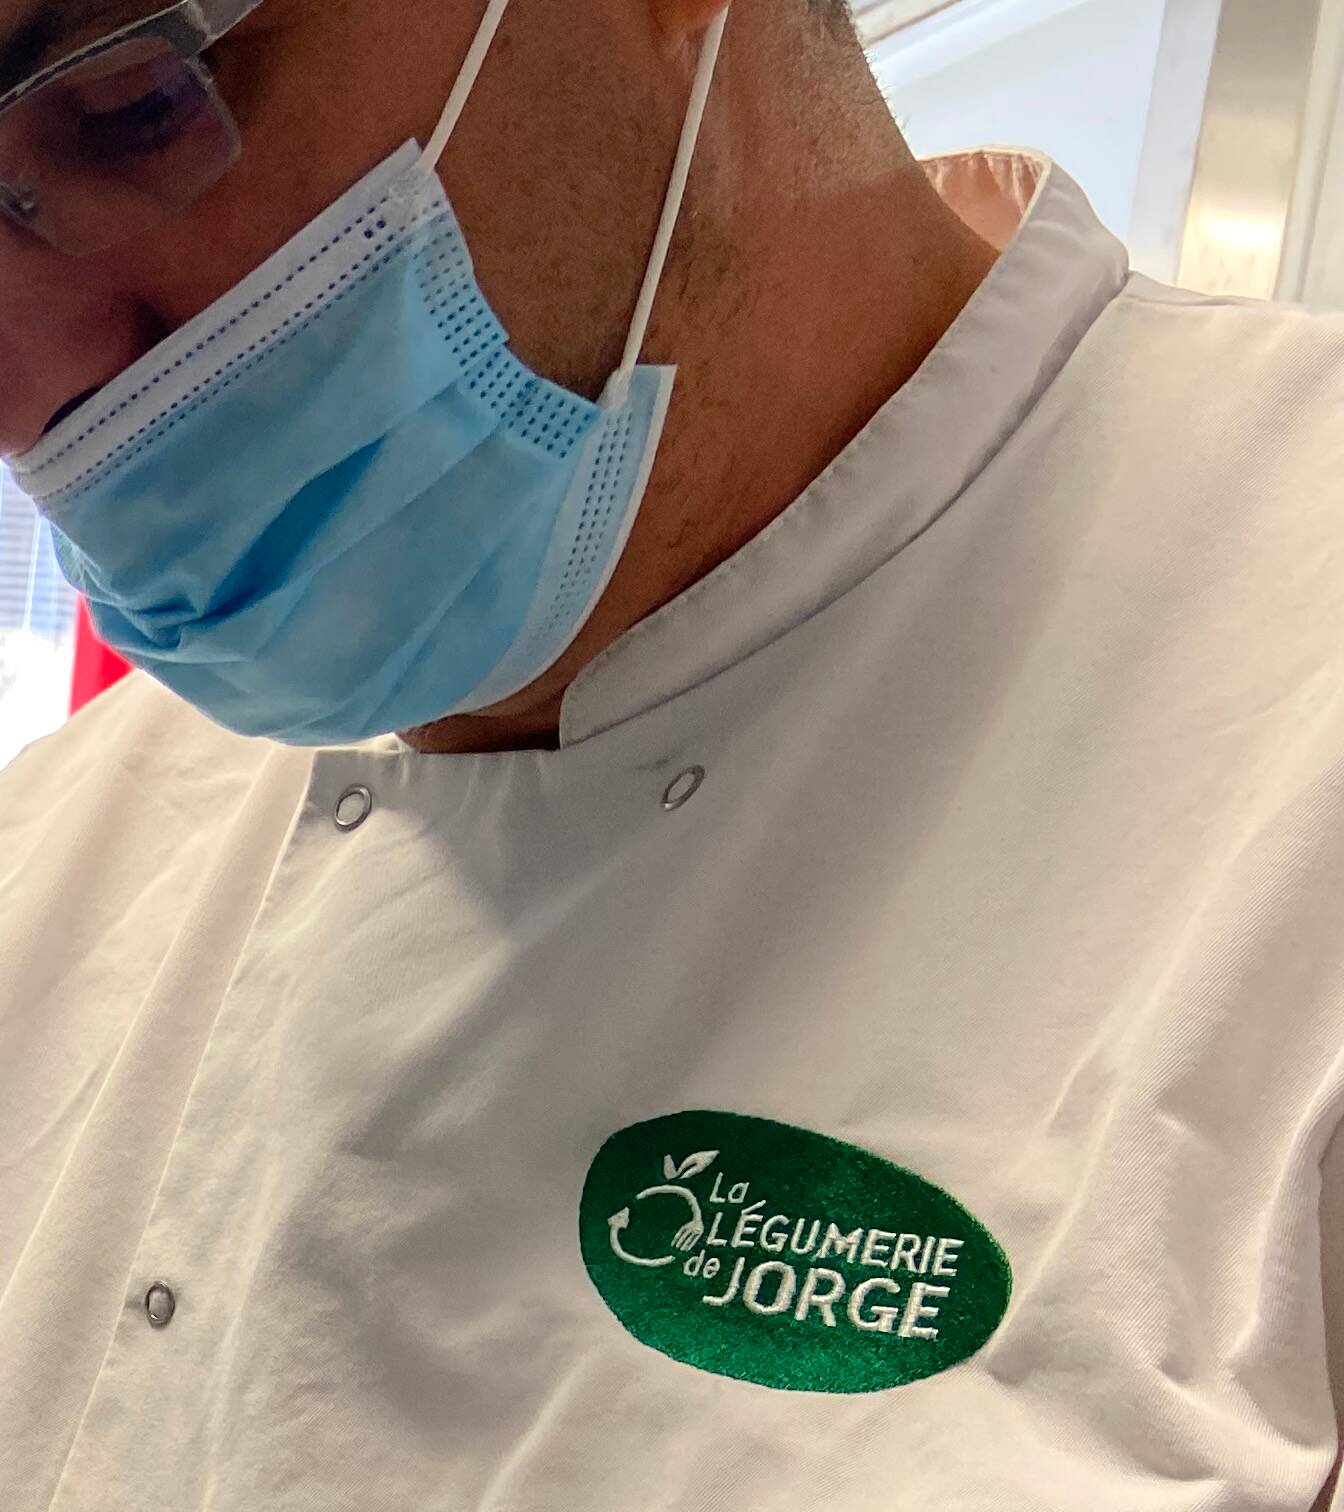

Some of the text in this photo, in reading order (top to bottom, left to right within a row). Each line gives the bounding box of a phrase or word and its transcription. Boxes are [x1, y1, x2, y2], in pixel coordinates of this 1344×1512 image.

[709, 1172, 750, 1205] La
[706, 1199, 965, 1277] LÉGUMERIE
[683, 1249, 951, 1339] de JORGE
